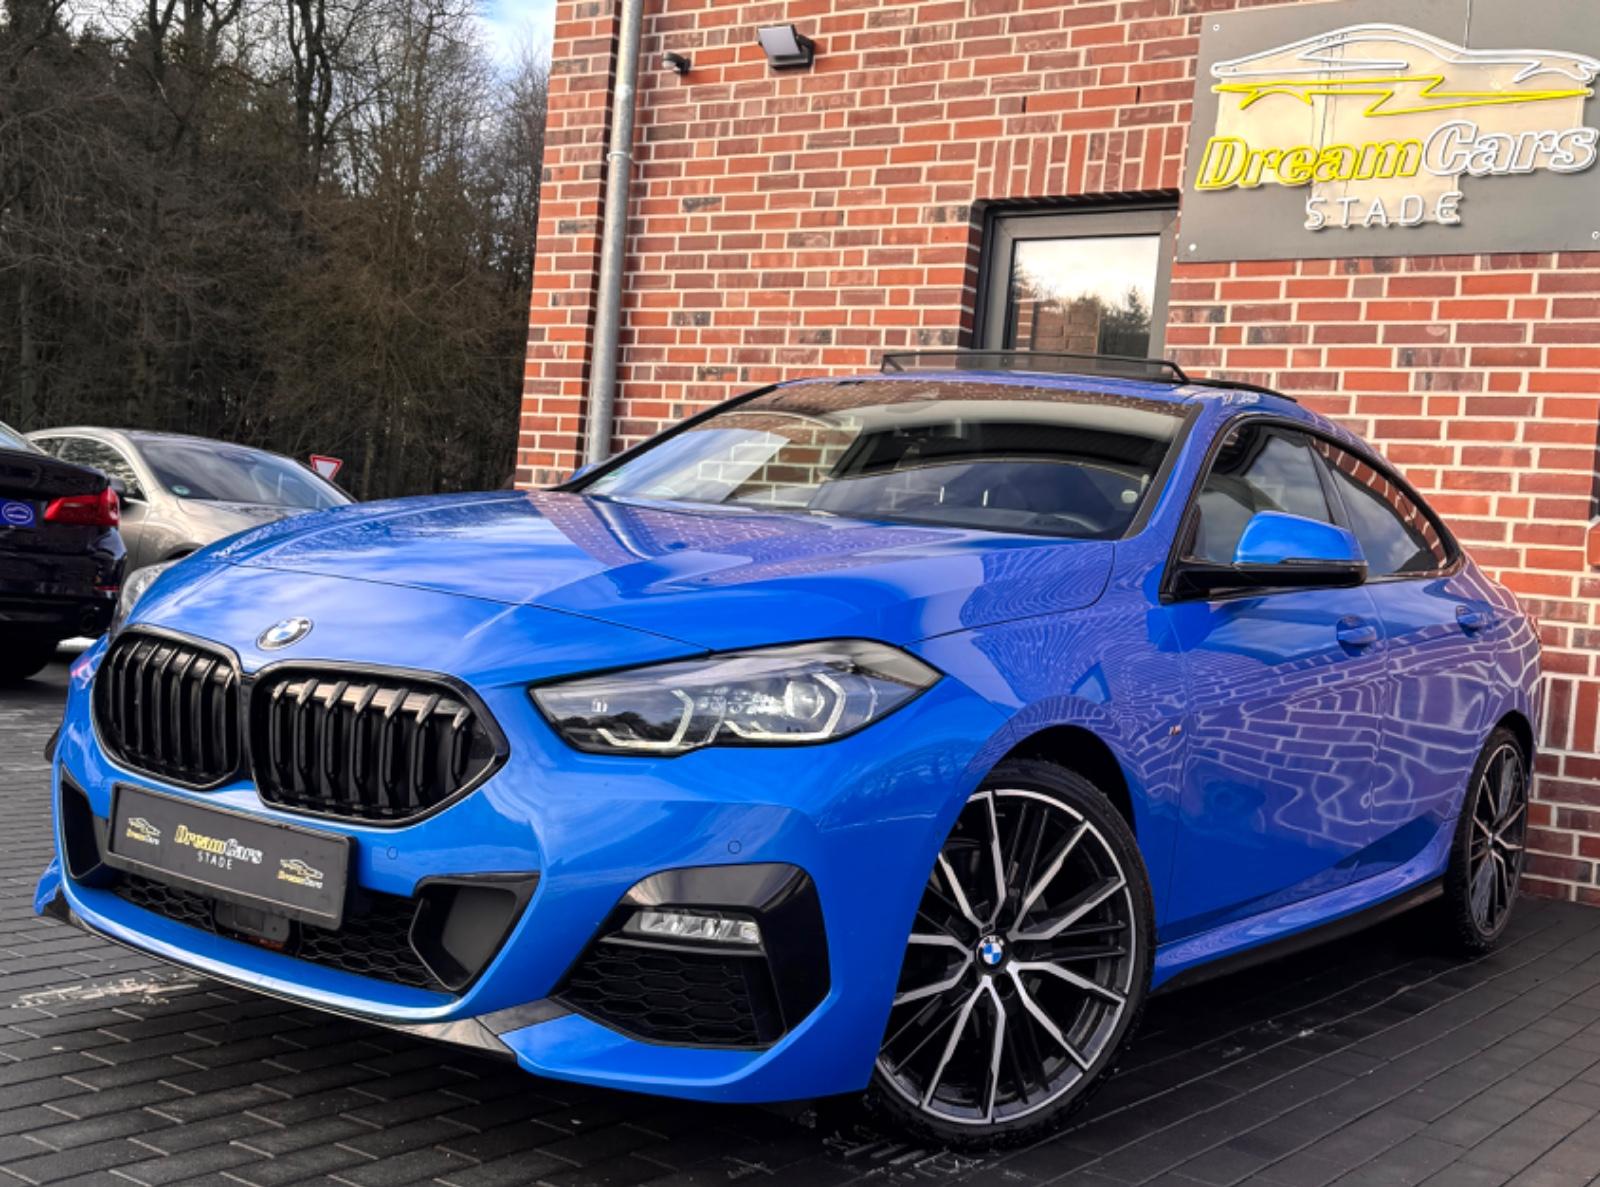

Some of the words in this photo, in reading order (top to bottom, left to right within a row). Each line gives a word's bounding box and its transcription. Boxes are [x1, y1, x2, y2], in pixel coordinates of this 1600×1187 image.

[1195, 120, 1599, 189] DreamCars
[1304, 192, 1463, 230] STADE
[174, 825, 263, 864] DreamCars
[197, 851, 233, 870] STADE
